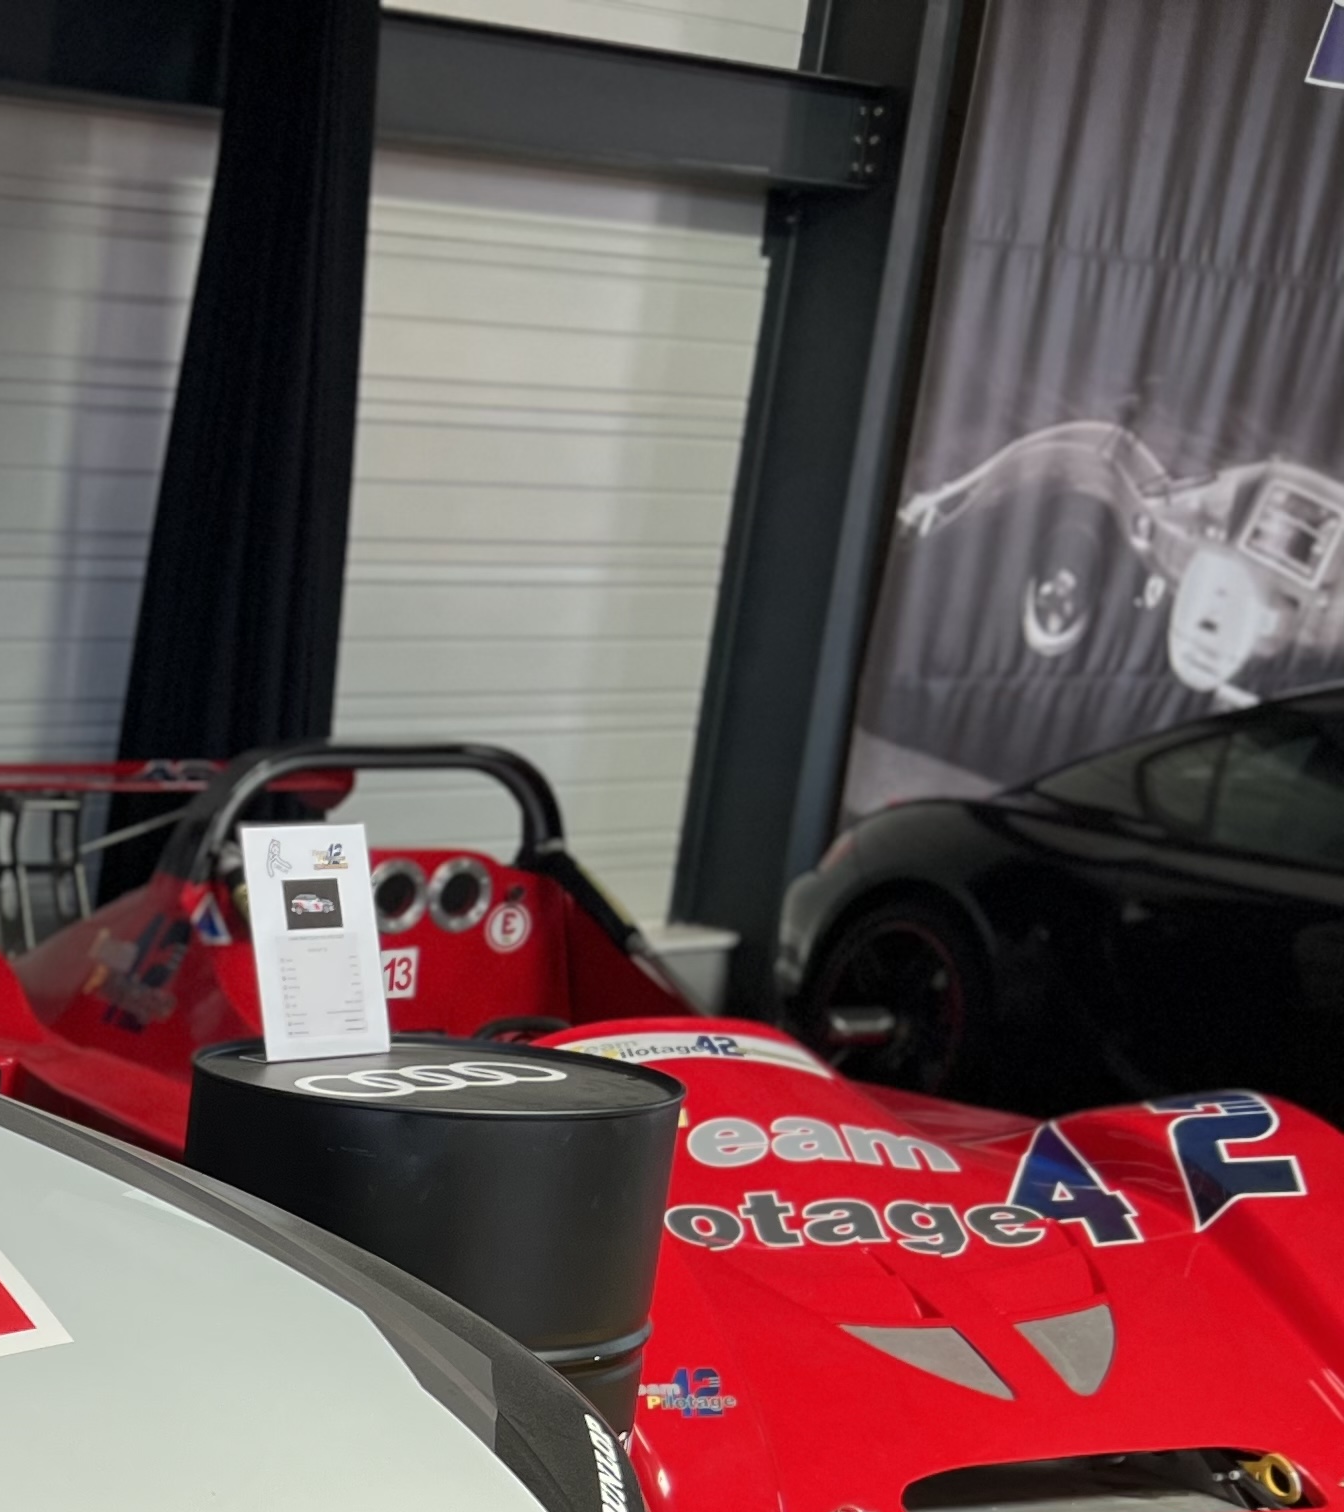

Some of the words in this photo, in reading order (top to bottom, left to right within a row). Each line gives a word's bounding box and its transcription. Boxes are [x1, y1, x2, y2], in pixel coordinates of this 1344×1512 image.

[501, 912, 517, 936] E
[383, 957, 413, 992] 13
[695, 1035, 744, 1057] 42
[682, 1114, 960, 1173] eam
[664, 1191, 1047, 1257] otage
